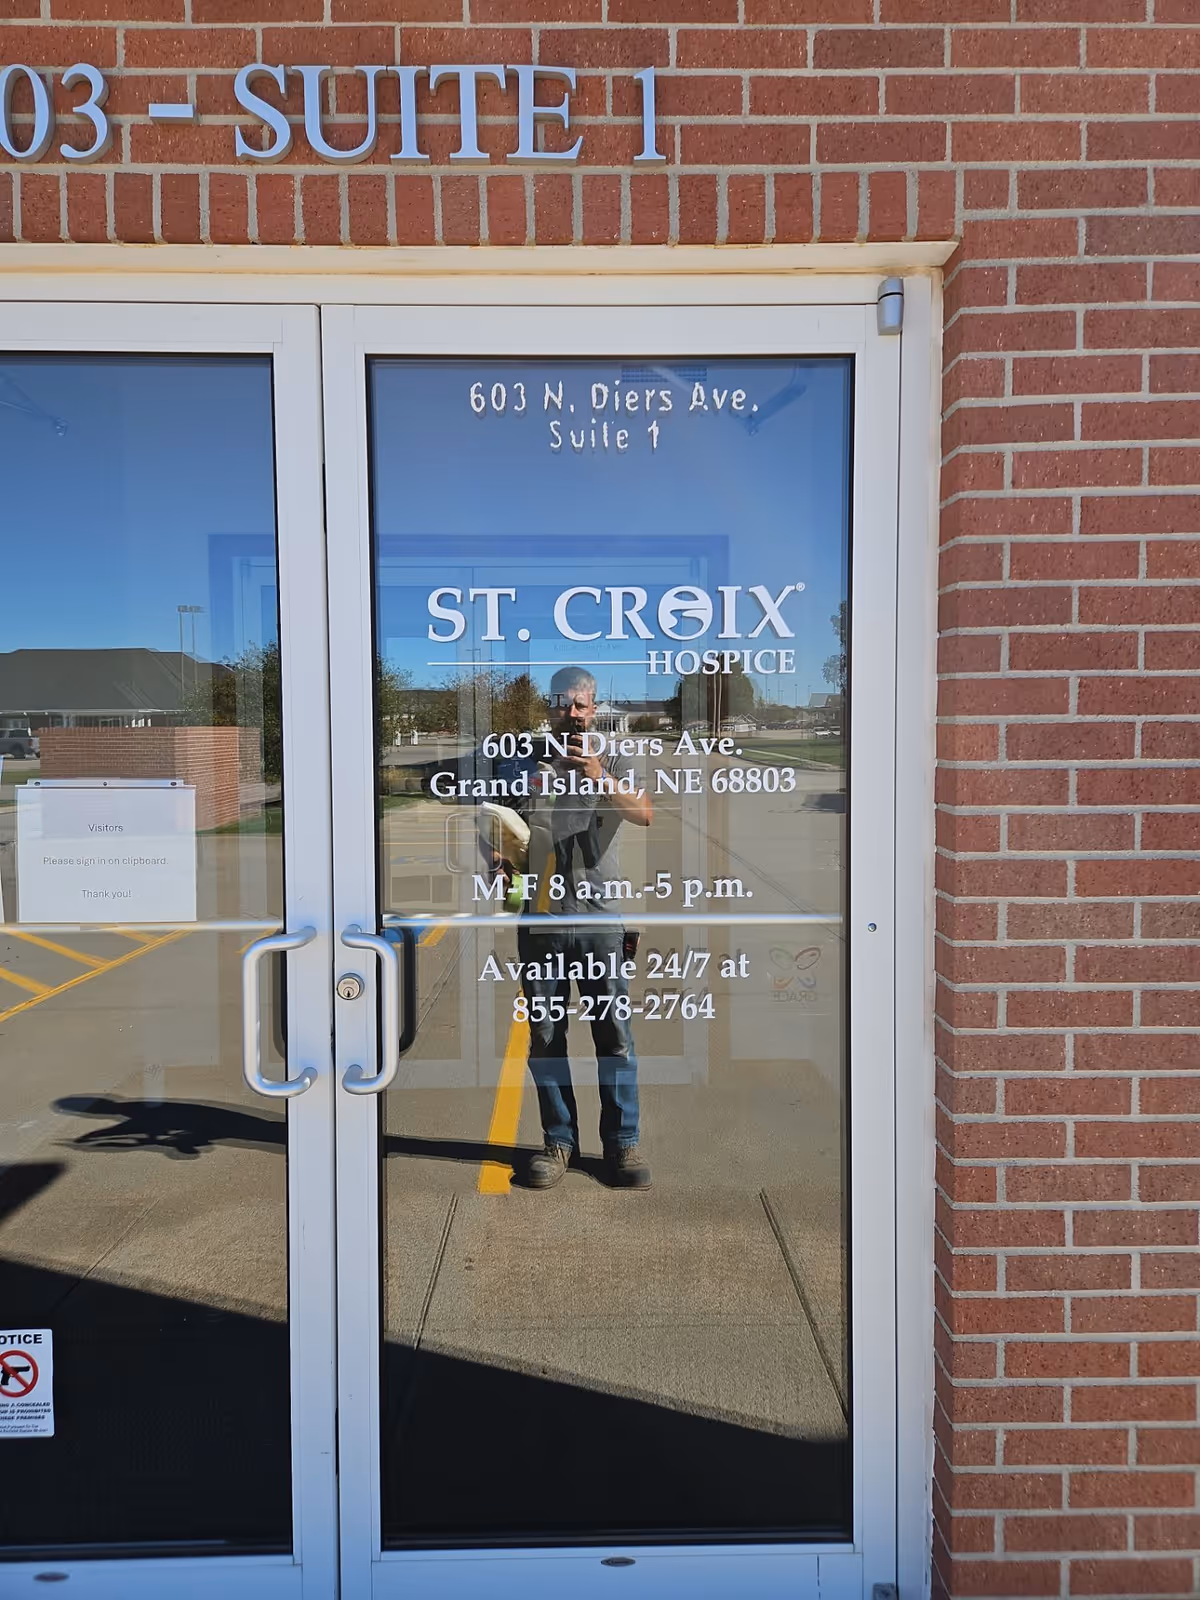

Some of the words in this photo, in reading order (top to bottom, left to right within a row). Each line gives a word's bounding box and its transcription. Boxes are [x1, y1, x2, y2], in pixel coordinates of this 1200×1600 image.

[0, 62, 112, 162] 03
[233, 63, 585, 166] SUITE
[633, 65, 669, 166] 1
[470, 382, 527, 413] 603
[543, 380, 576, 413] N.
[591, 380, 673, 412] Diers
[689, 382, 760, 412] Ave.
[648, 420, 660, 449] 1
[427, 587, 531, 643] ST.
[647, 649, 797, 676] HOSPICE
[482, 731, 534, 759] 603
[543, 732, 569, 758] N
[582, 731, 664, 757] Diers
[673, 730, 744, 757] Ave.
[430, 771, 531, 798] Grand
[539, 766, 646, 801] Island,
[654, 767, 704, 794] NE
[711, 766, 797, 794] 68803
[88, 824, 123, 833] Visitors
[43, 856, 74, 866] Please
[76, 856, 95, 867] sign
[97, 856, 106, 866] in
[108, 857, 120, 866] on
[122, 856, 169, 867] clipboard.
[81, 889, 110, 899] Thank
[111, 889, 132, 900] you!
[471, 874, 539, 902] M-F
[548, 873, 566, 900] 8
[575, 872, 673, 900] a.m.-5
[682, 876, 754, 908] p.m.
[478, 952, 637, 982] Available
[646, 950, 711, 981] 24/7
[719, 953, 751, 979] at
[512, 993, 716, 1023] 855-278-2764
